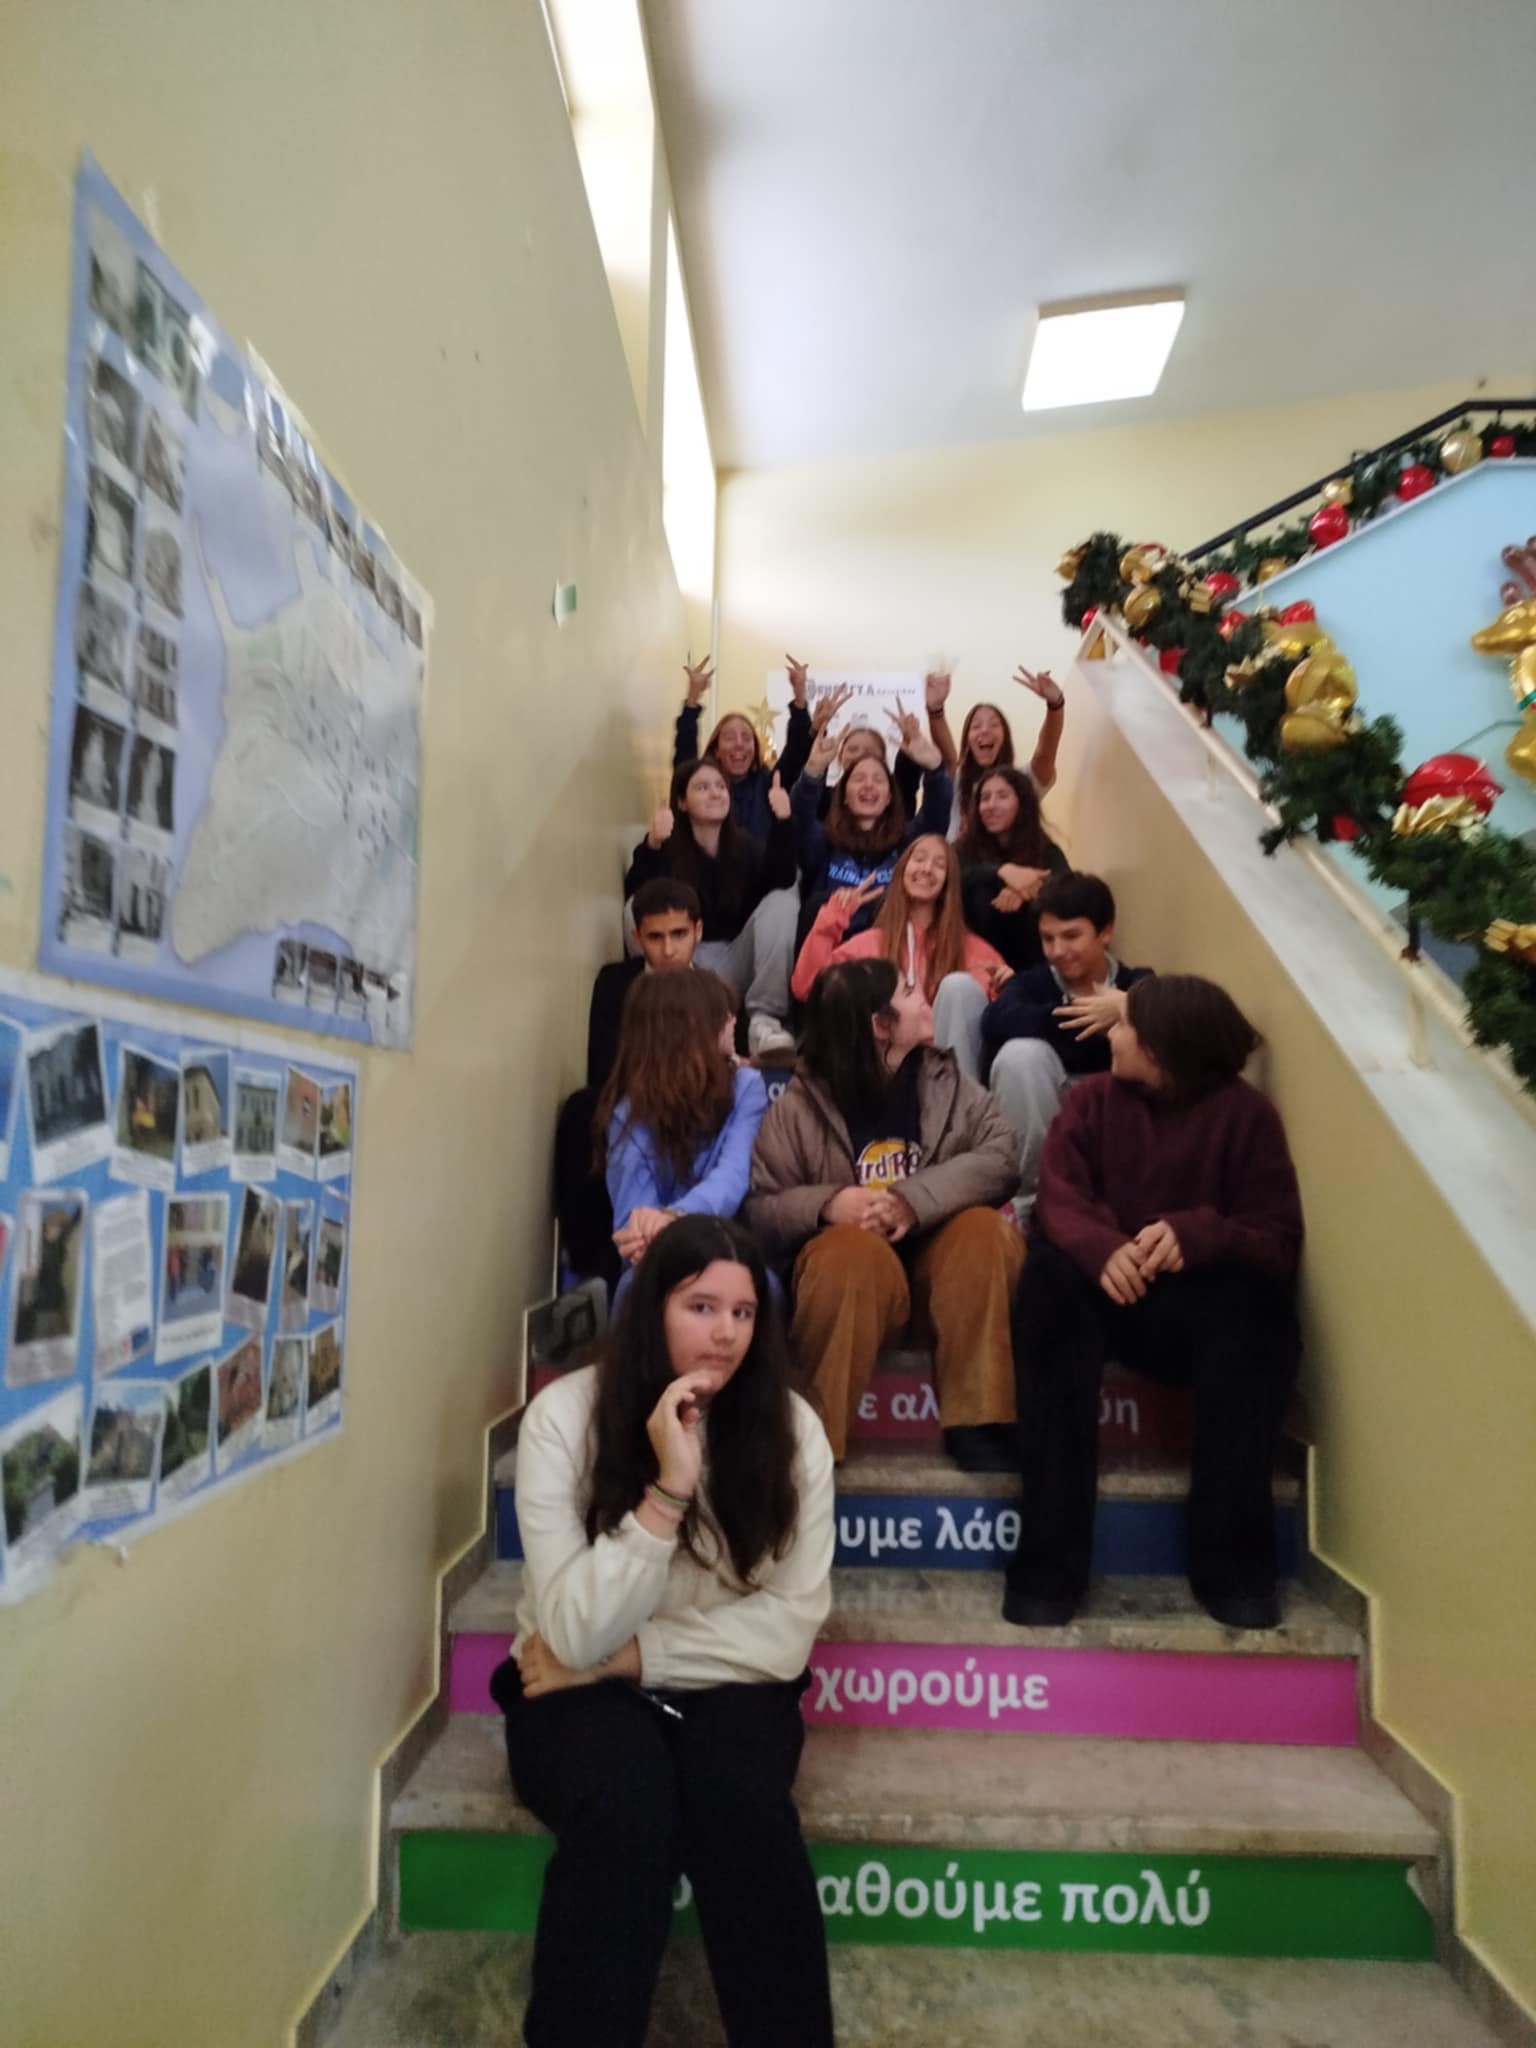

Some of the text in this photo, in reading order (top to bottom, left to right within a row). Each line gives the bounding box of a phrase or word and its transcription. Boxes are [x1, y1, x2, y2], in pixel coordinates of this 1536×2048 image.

[858, 1392, 878, 1421] ε
[839, 1506, 1022, 1558] υμε λάθ
[814, 1657, 1049, 1719] χωρούμε
[816, 1861, 1210, 1933] αθούμε πολύ
